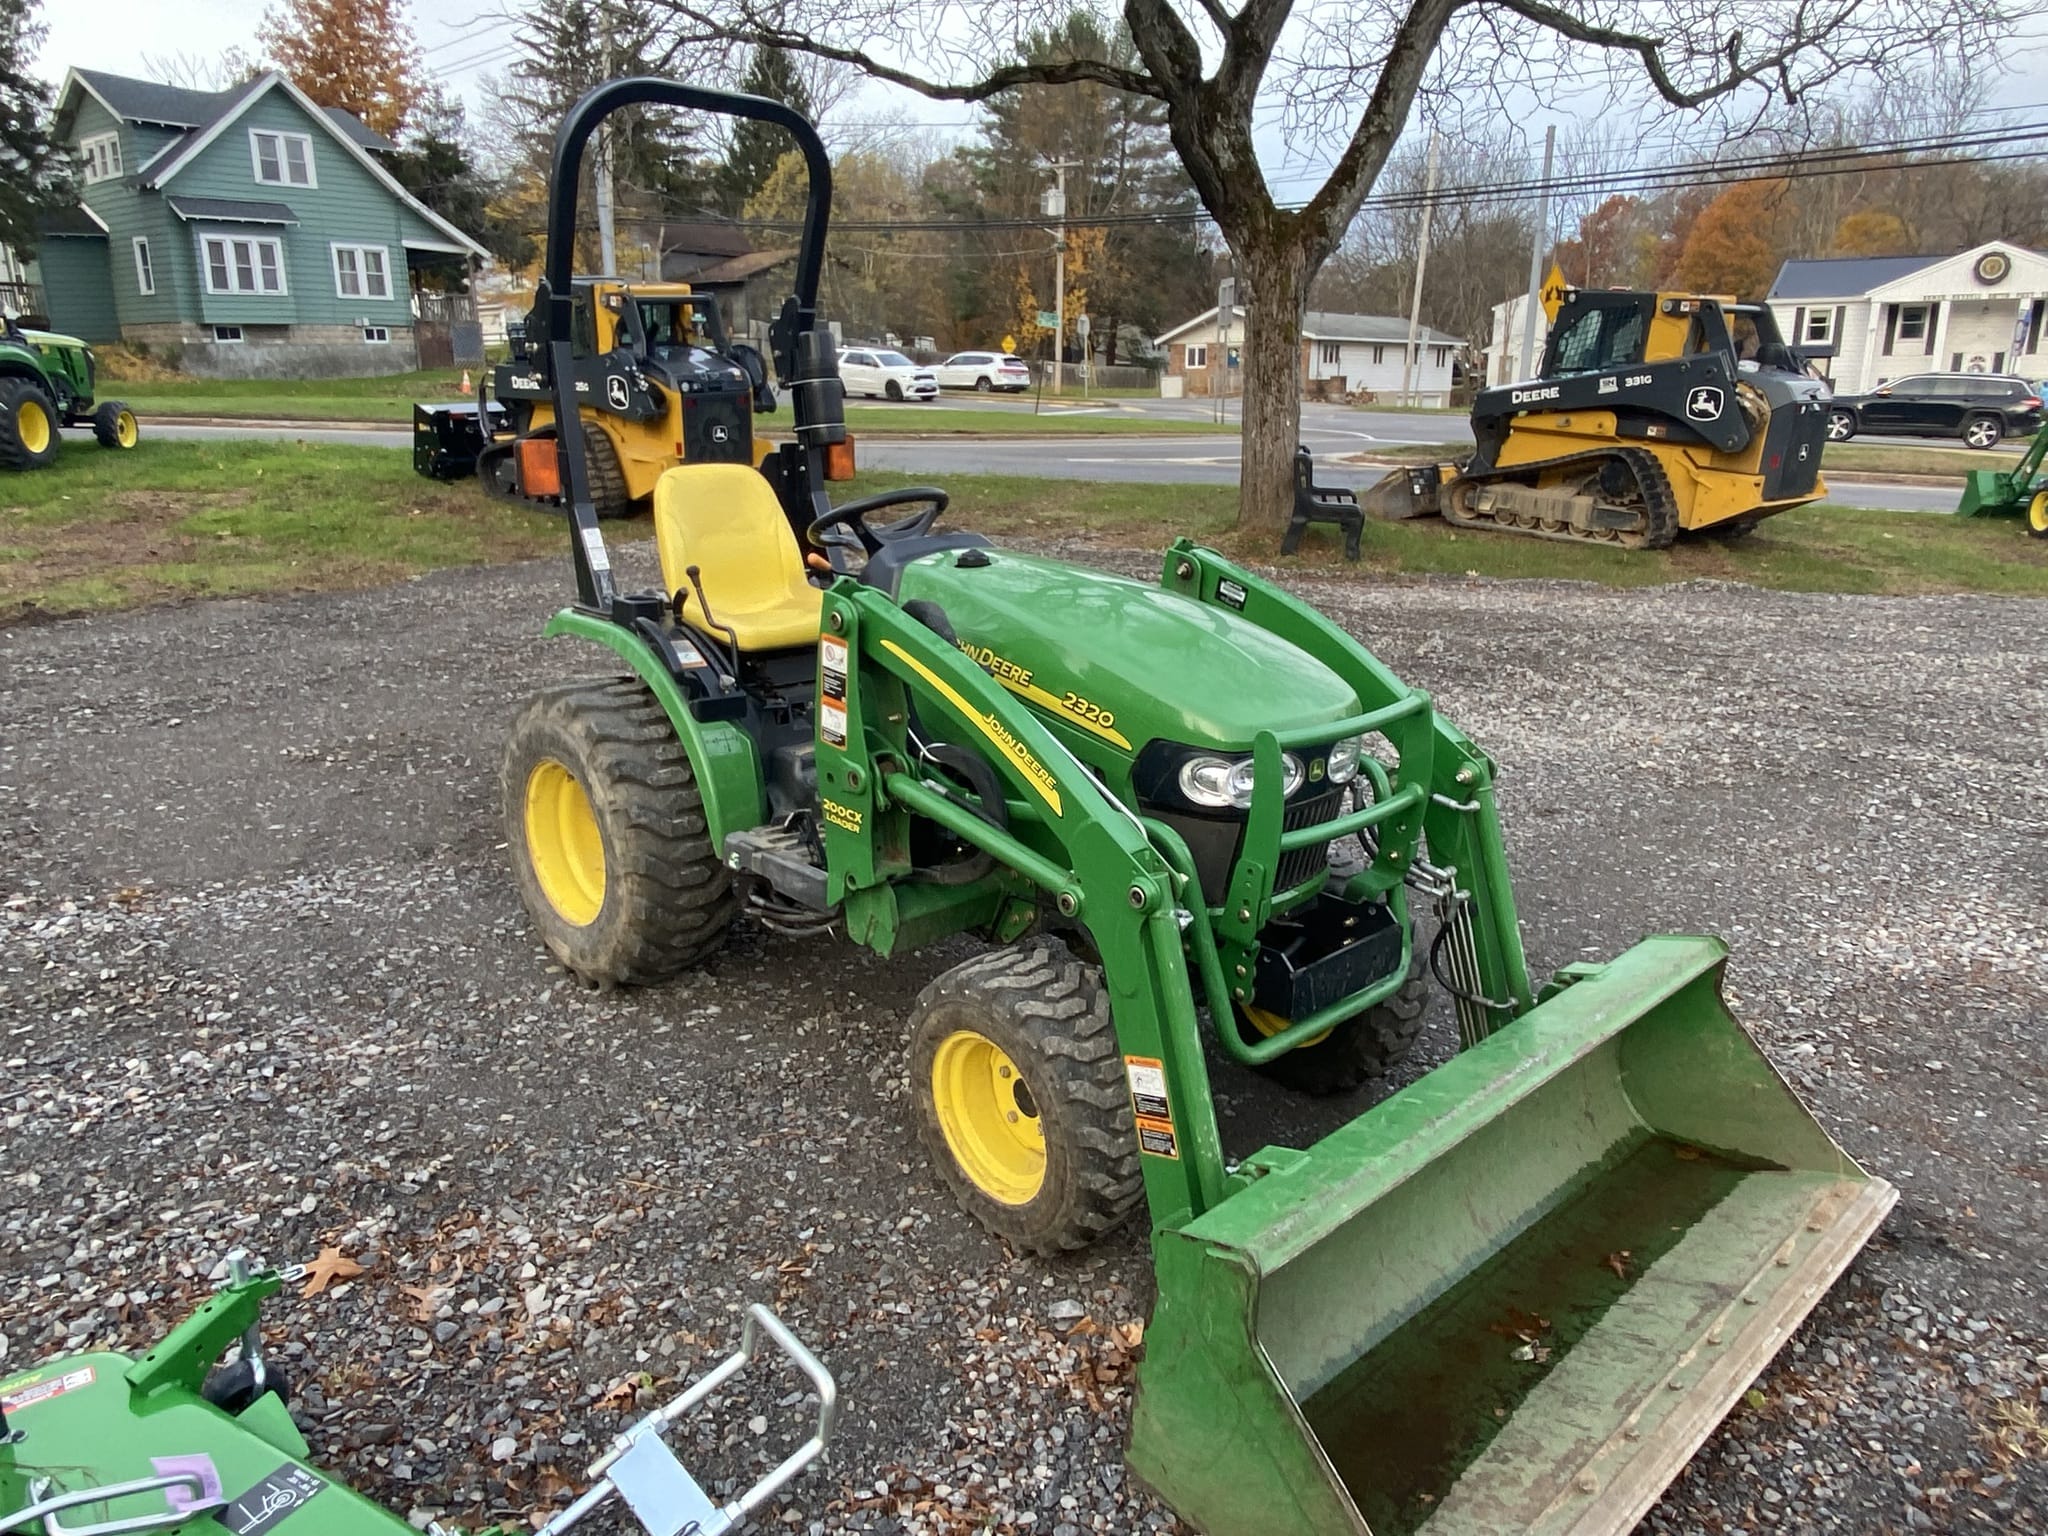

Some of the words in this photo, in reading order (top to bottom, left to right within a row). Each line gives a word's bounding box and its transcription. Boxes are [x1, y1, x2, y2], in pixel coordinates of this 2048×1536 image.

[1511, 387, 1560, 404] DEERE
[1624, 375, 1652, 387] 331G
[979, 648, 1033, 687] DEERE
[1061, 691, 1114, 728] 2320
[983, 714, 1016, 748] JOHN
[1014, 742, 1057, 790] DEERE
[823, 798, 862, 824] 200CX
[826, 812, 860, 834] LOADER
